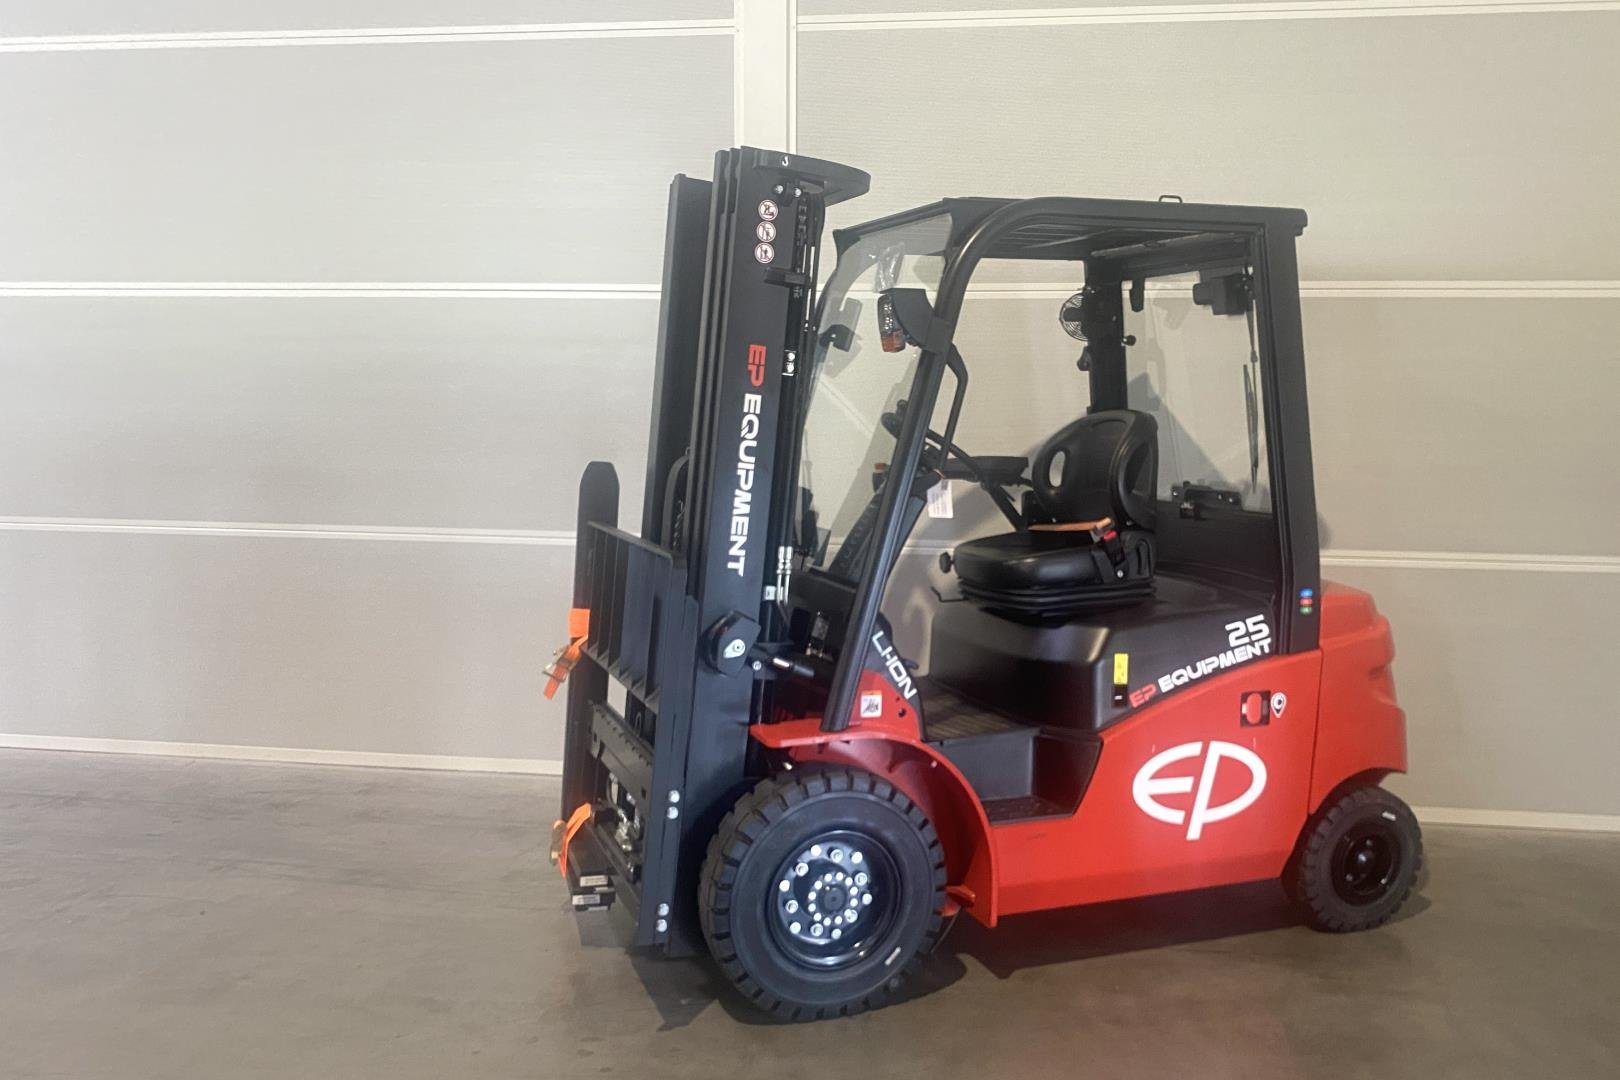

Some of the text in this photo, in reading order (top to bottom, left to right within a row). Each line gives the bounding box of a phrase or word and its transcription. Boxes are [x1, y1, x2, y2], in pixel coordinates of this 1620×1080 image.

[726, 343, 767, 577] EP EQUIPMENT
[1129, 637, 1272, 708] EP EQUIPMENT
[1224, 613, 1270, 648] 25
[1132, 739, 1268, 842] EP
